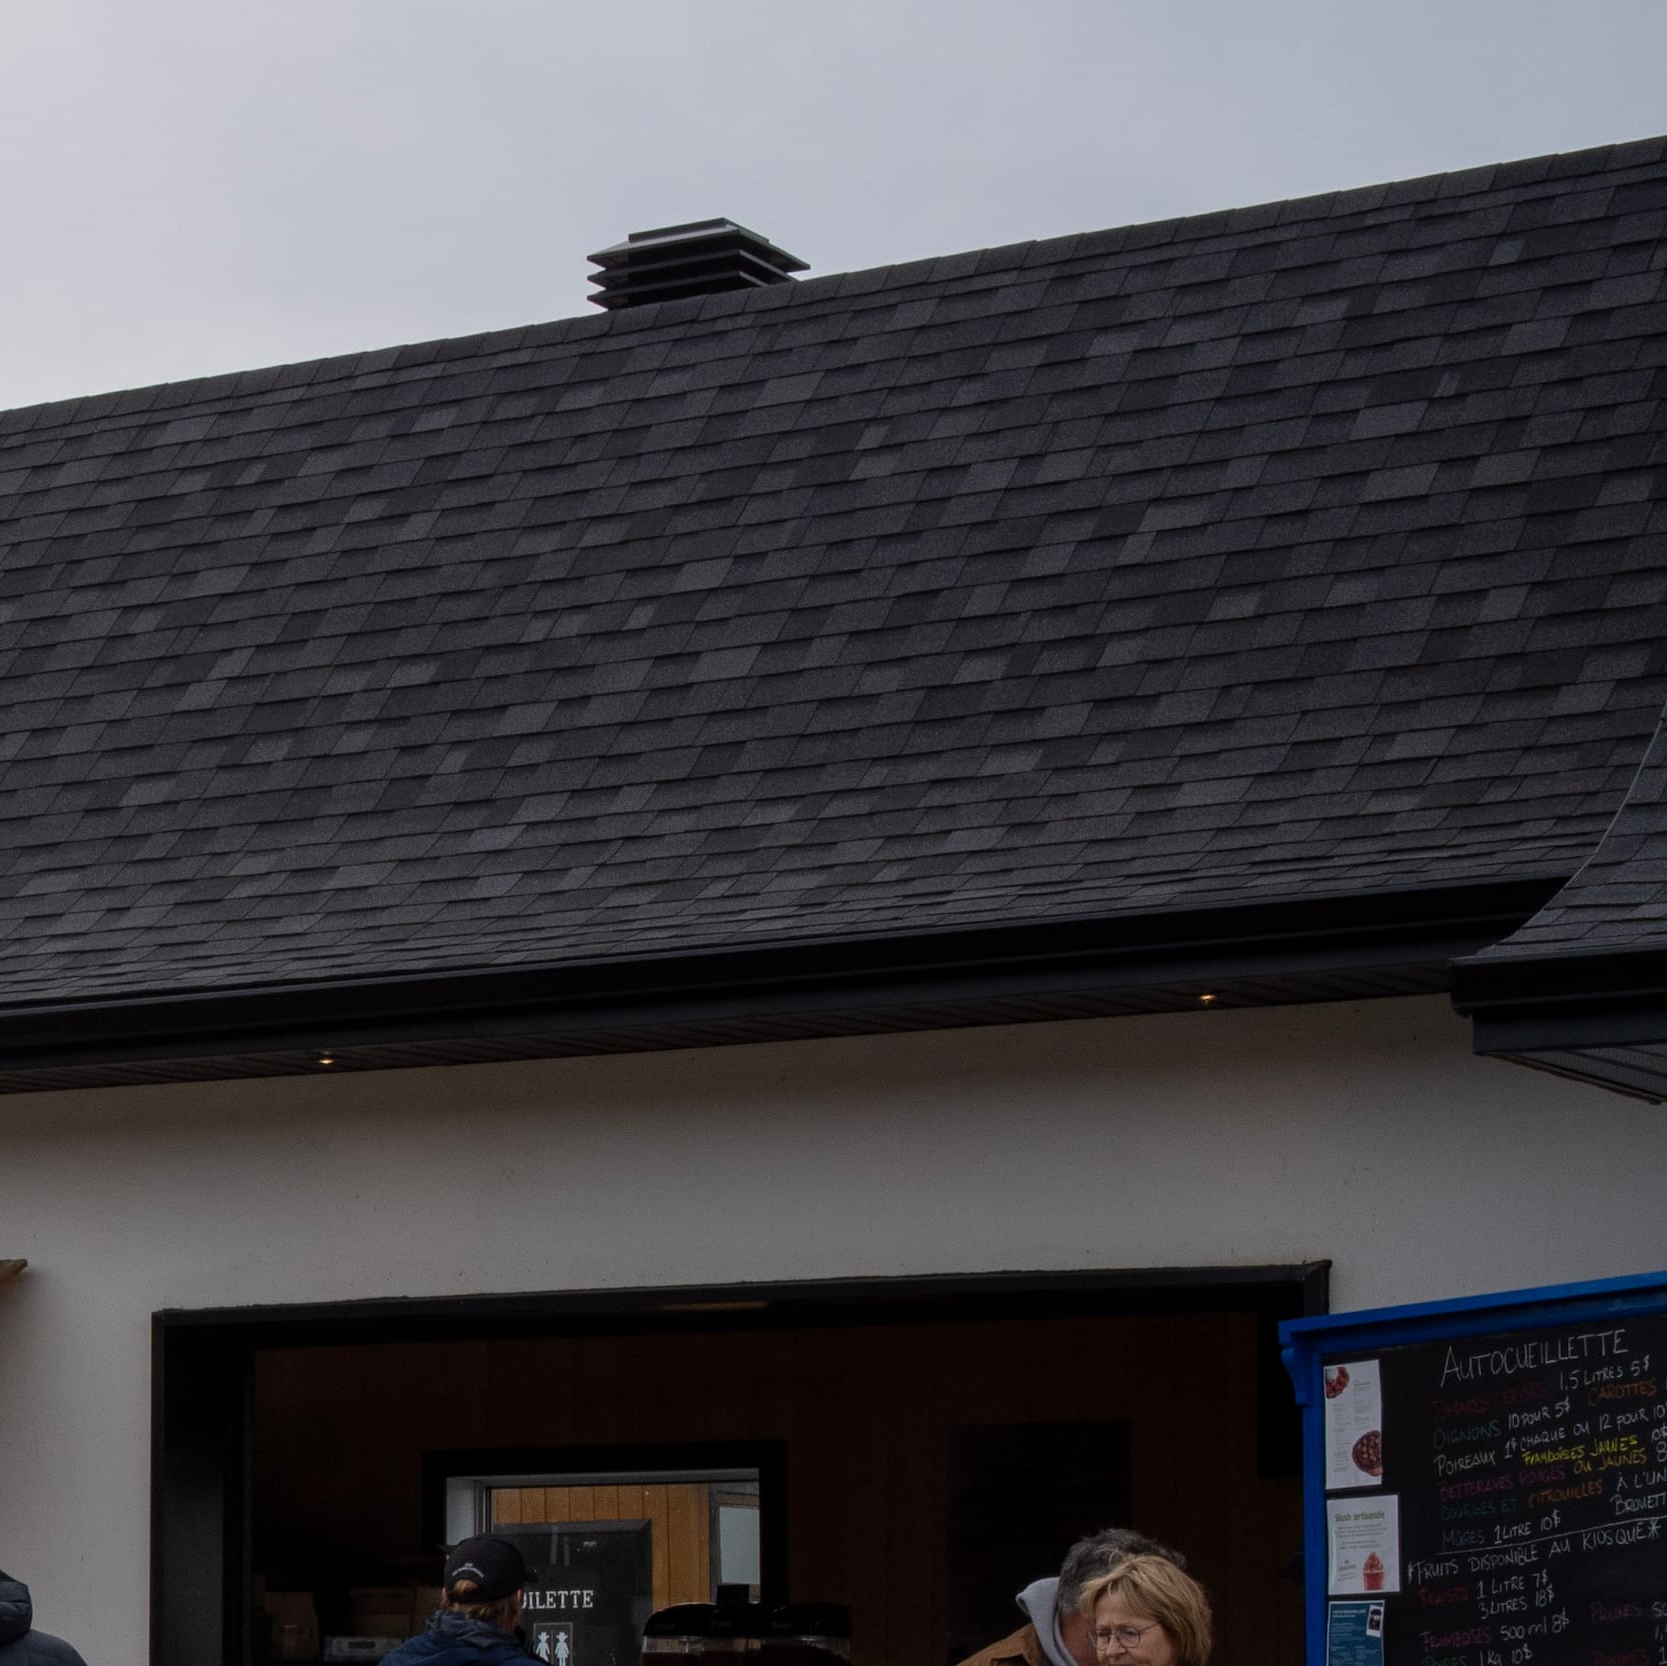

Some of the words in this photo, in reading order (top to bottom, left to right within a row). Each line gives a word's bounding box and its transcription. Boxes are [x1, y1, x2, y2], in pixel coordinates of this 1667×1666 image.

[1440, 1330, 1628, 1388] AUTOCUEILLETTE
[1630, 1354, 1651, 1377] 5$
[1589, 1378, 1658, 1407] CAROTTES
[1434, 1419, 1500, 1449] OIGNONS
[1508, 1412, 1520, 1430] 10
[1520, 1406, 1551, 1427] POUR
[1555, 1395, 1571, 1418] 5$
[1433, 1451, 1497, 1477] POIREAUX
[1520, 1427, 1566, 1452] CHAQUE
[1573, 1420, 1590, 1436] OU
[1599, 1412, 1612, 1432] 12
[1616, 1407, 1649, 1431] POUR
[1590, 1434, 1638, 1457] JAUNES
[1574, 1459, 1593, 1474] OU
[1598, 1447, 1647, 1470] JAUNES
[1438, 1474, 1515, 1502] BETTERAVES
[1519, 1463, 1566, 1487] ROUGES
[1499, 1496, 1518, 1512] ET
[1528, 1477, 1603, 1508] CITROUILLES
[1540, 1508, 1562, 1532] 10$
[1467, 1544, 1539, 1572] DISPONIBLE
[1547, 1536, 1571, 1559] AU
[1477, 1580, 1488, 1600] 1
[1531, 1568, 1548, 1588] 7$
[1478, 1601, 1489, 1620] 3
[1535, 1583, 1555, 1608] 18$
[1590, 1600, 1643, 1624] PRUNES
[1419, 1625, 1492, 1653] FRAMBOISES
[1499, 1625, 1525, 1641] 500
[1528, 1615, 1548, 1636] ml
[1551, 1605, 1571, 1633] 8$
[1511, 1643, 1534, 1664] 10$
